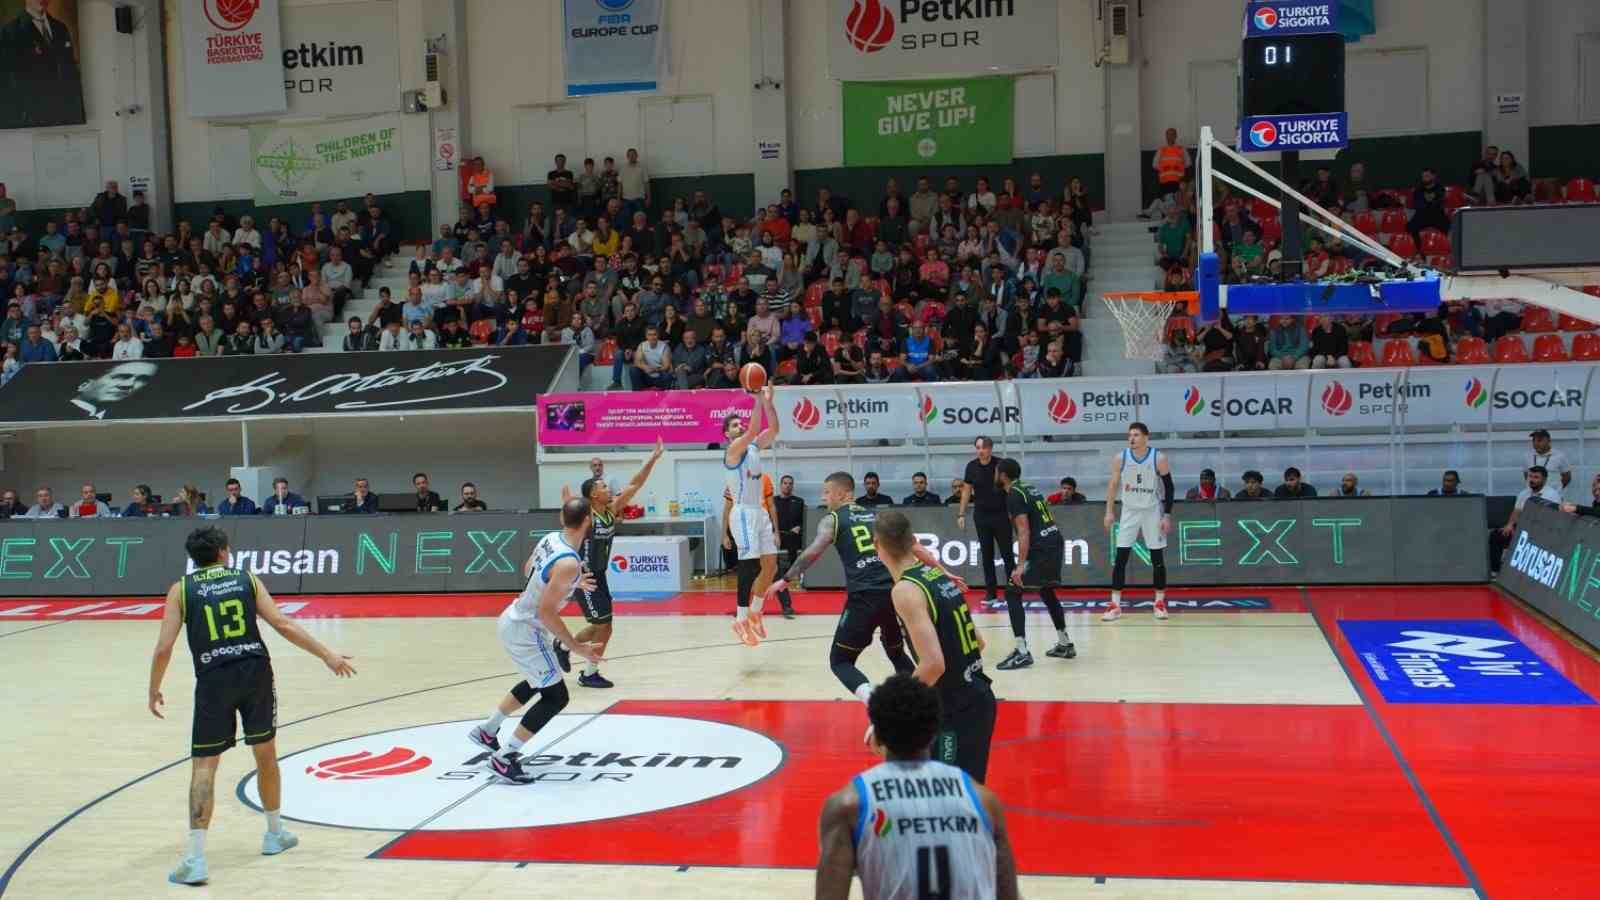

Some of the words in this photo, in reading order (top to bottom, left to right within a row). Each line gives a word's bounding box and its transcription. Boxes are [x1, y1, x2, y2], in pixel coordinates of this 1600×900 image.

[599, 14, 631, 24] FIBA
[206, 32, 263, 48] TÜRKİYE
[571, 26, 628, 38] EUROPE
[631, 24, 658, 35] CUP
[902, 31, 980, 50] SPOR
[207, 45, 263, 57] BASKETBOL
[282, 42, 364, 69] etkim
[284, 78, 333, 93] POR
[887, 87, 966, 114] NEVER
[878, 112, 931, 135] GIVE
[938, 105, 977, 128] UP!
[315, 134, 377, 154] CHILDREN
[379, 127, 398, 140] OF
[320, 151, 348, 163] THE
[350, 141, 392, 159] NORTH
[826, 398, 889, 415] Petkim
[1082, 391, 1150, 408] Petkim
[1210, 397, 1293, 417] SOCAR
[1493, 389, 1584, 409] SOCAR
[826, 418, 870, 429] SPOR
[943, 406, 1021, 425] SOCAR
[1082, 411, 1129, 423] SPOR
[912, 533, 1089, 567] Born
[1510, 530, 1564, 589] Borusan
[1559, 544, 1600, 621] NE
[203, 598, 247, 641] 13
[952, 603, 979, 656] 12
[437, 770, 634, 783] SOR
[871, 777, 964, 802] EFIANAYI
